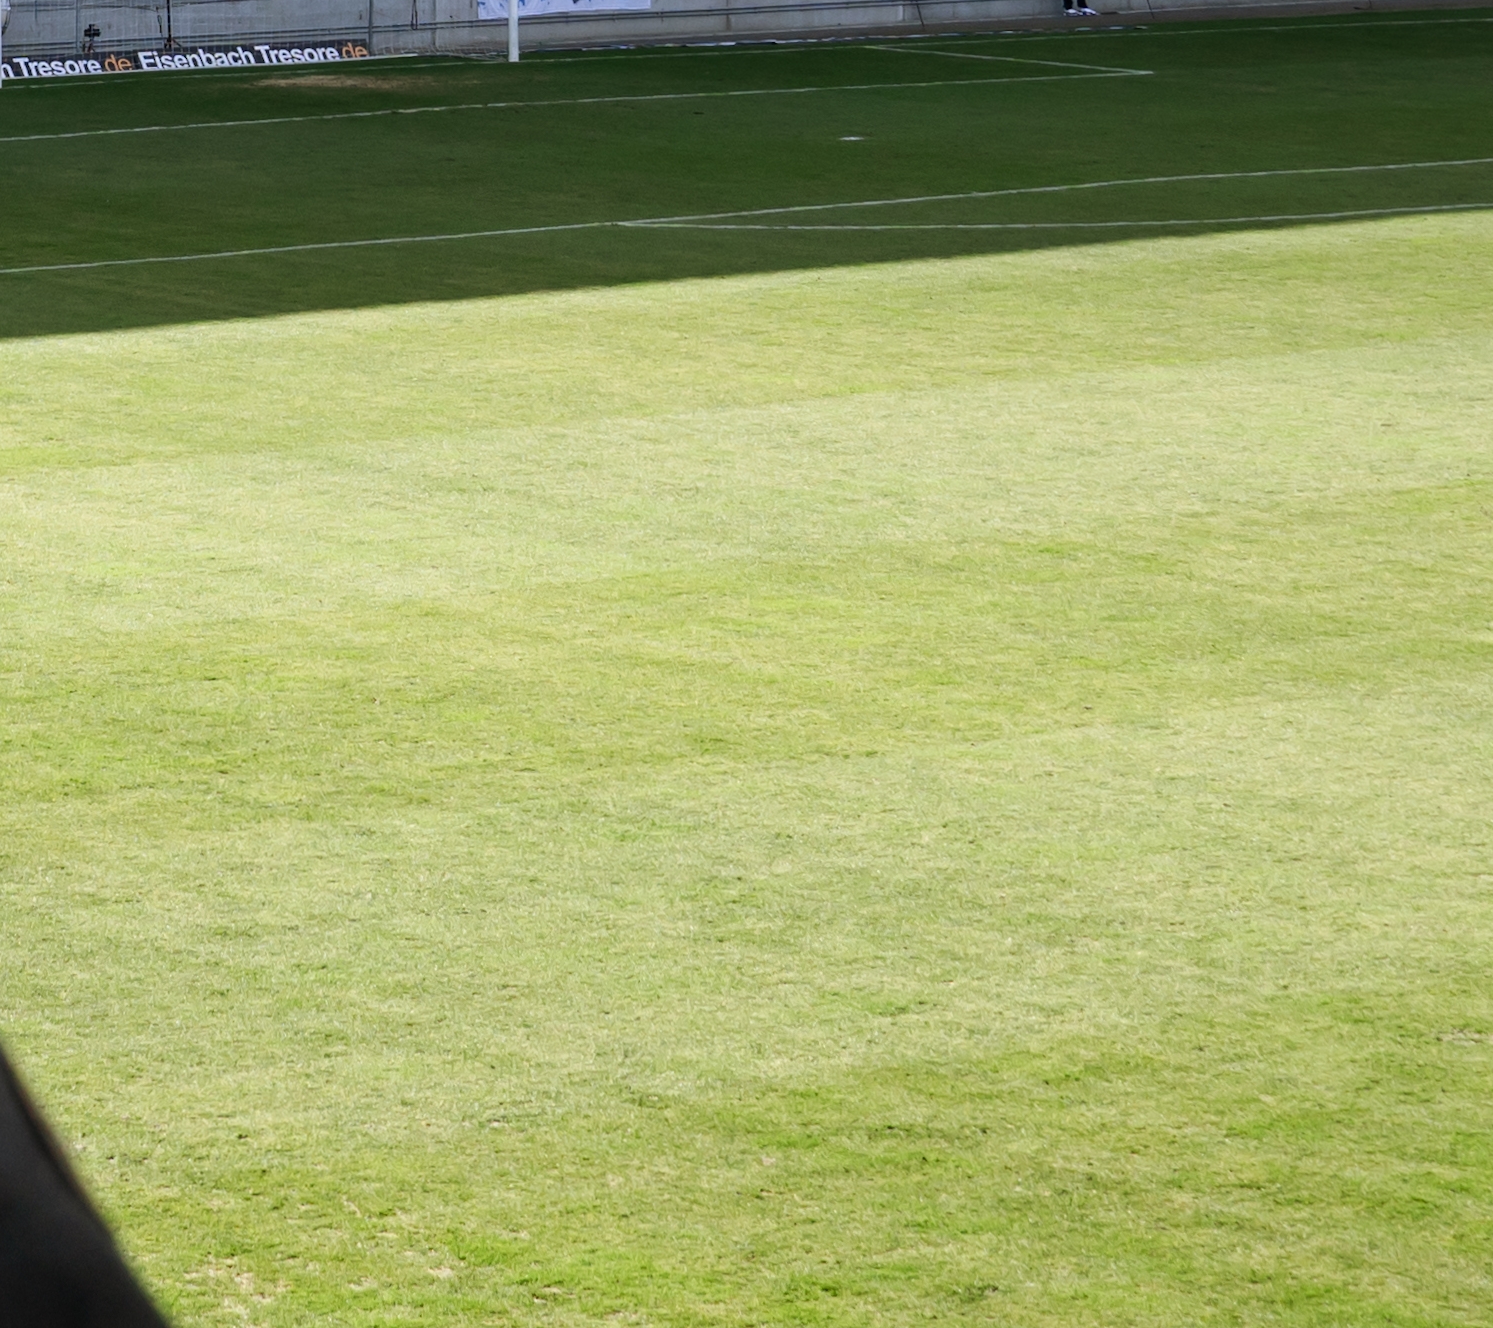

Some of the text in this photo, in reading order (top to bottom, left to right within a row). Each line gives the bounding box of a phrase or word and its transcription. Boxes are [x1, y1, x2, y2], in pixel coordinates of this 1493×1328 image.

[11, 55, 102, 78] Tresore
[137, 46, 256, 71] Eisenbach
[254, 42, 341, 65] Tresore
